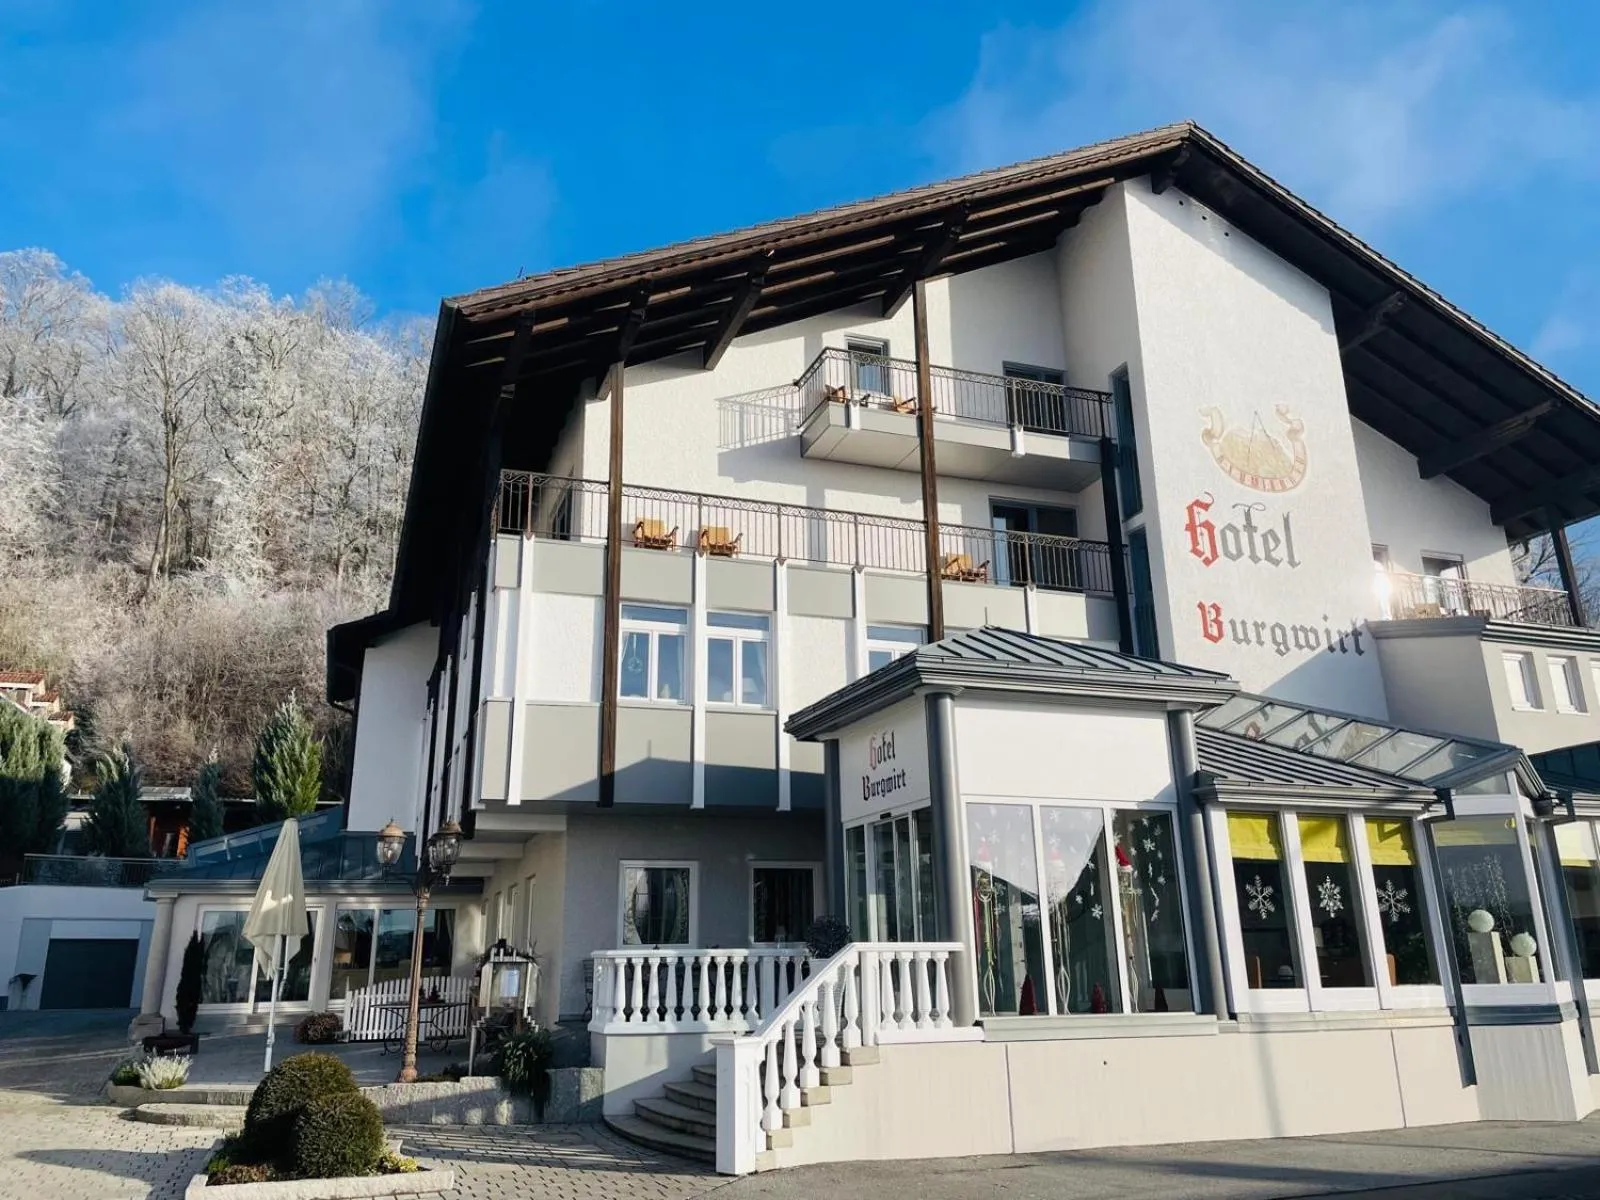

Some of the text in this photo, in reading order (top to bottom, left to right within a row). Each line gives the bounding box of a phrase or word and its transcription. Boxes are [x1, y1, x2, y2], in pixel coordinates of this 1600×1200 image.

[1185, 492, 1301, 569] Hotel
[1197, 600, 1365, 657] Burgwirt
[869, 730, 896, 770] Hotel
[862, 768, 906, 801] Burgwirt
